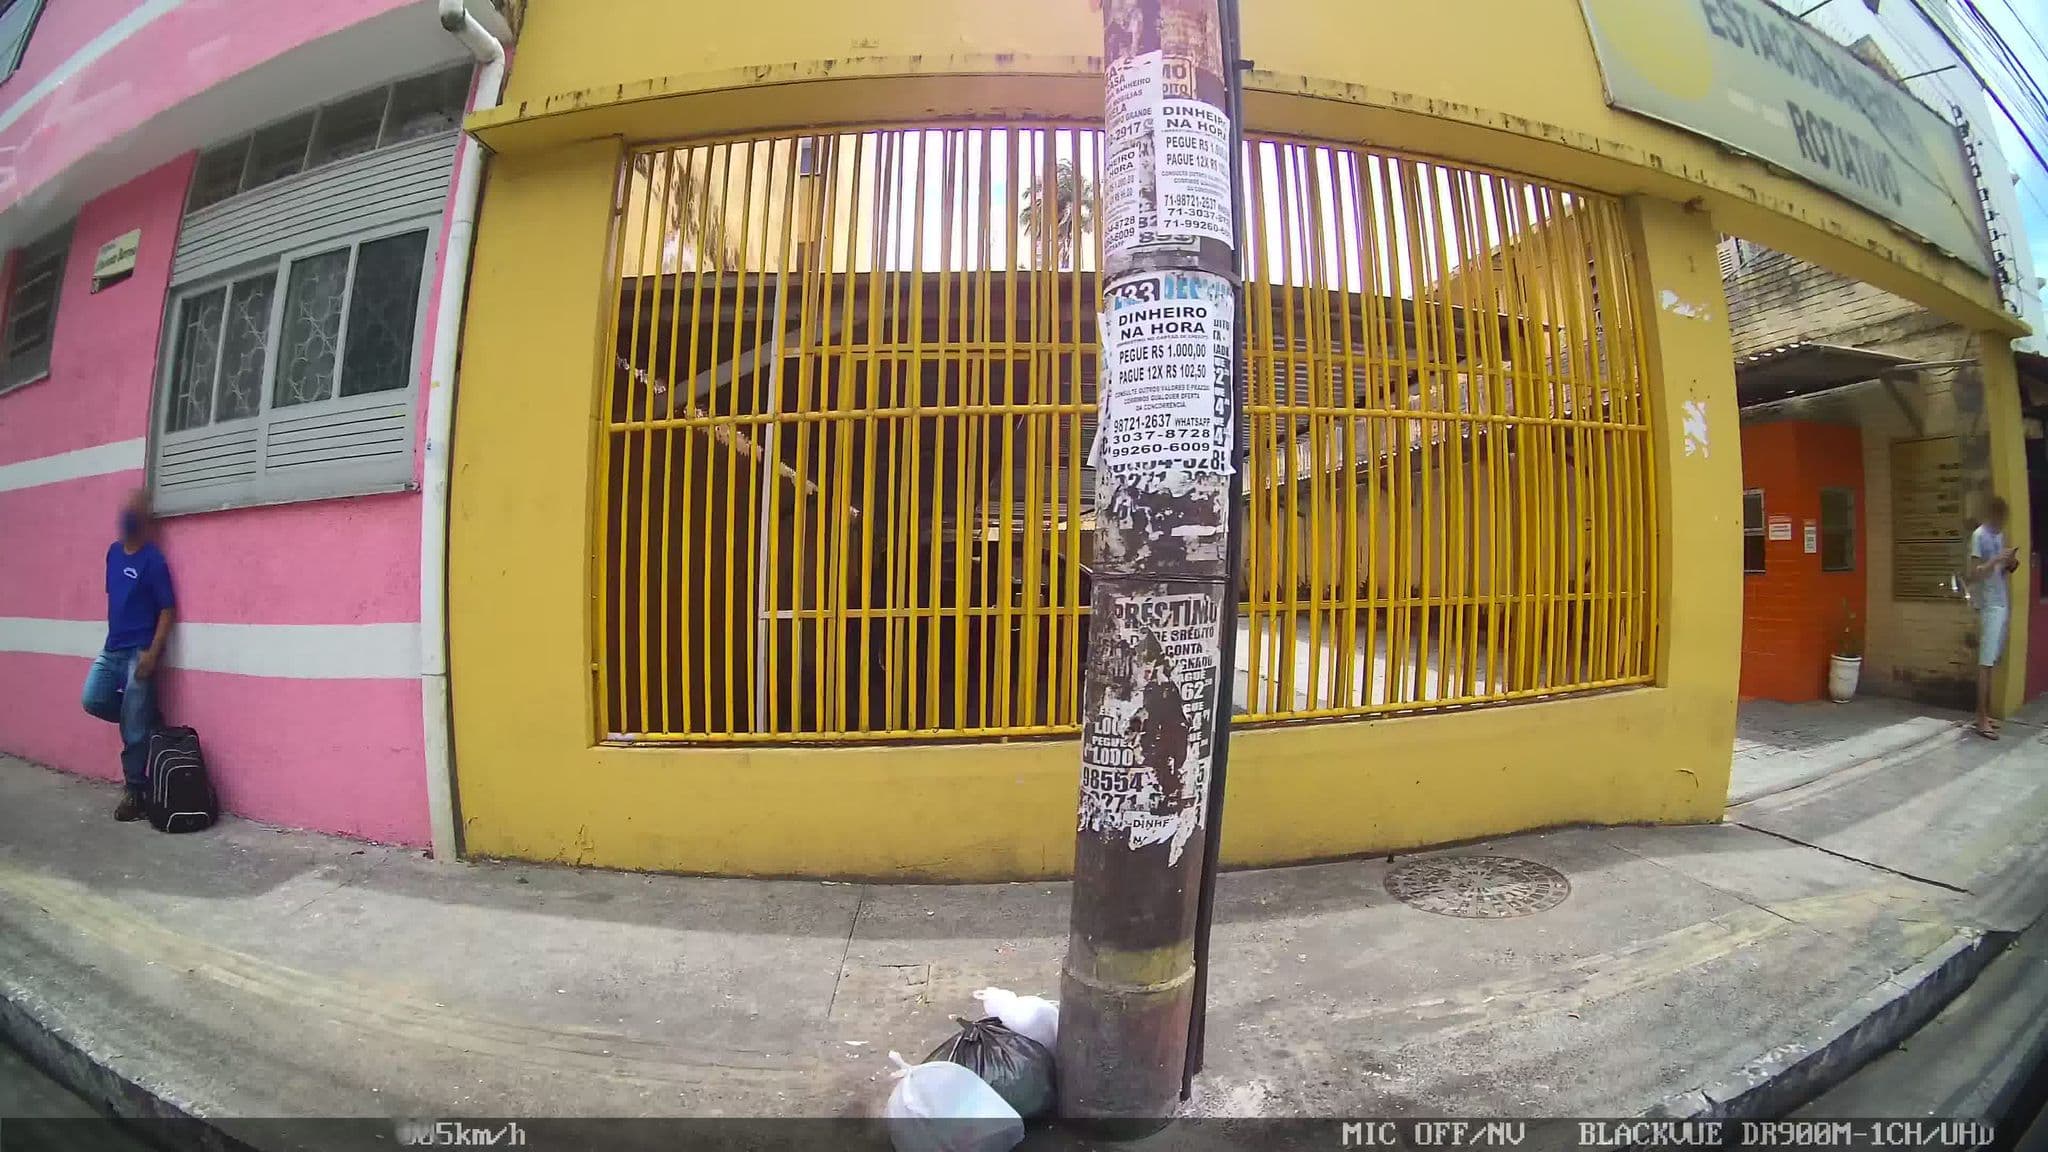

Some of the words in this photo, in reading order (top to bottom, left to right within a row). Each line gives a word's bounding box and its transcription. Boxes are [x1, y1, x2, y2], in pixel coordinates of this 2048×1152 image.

[1167, 118, 1192, 128] NA
[1166, 136, 1197, 149] PEGUE
[1166, 153, 1194, 166] PAGUE
[1119, 306, 1207, 326] DINHEIRO
[1120, 326, 1144, 341] NA
[1151, 321, 1205, 335] HORA
[1119, 346, 1149, 365] PEGUE
[1168, 343, 1206, 360] 1.000,00
[1119, 367, 1145, 384] PAGUE
[1148, 364, 1163, 380] 12X
[1180, 363, 1206, 380] 102,50
[1114, 414, 1171, 433] 98721-2637
[1175, 417, 1211, 427] WHATSAPP
[1113, 429, 1210, 444] 3037-8728
[1112, 442, 1210, 457] 99260-6009
[1082, 766, 1145, 793] 98554
